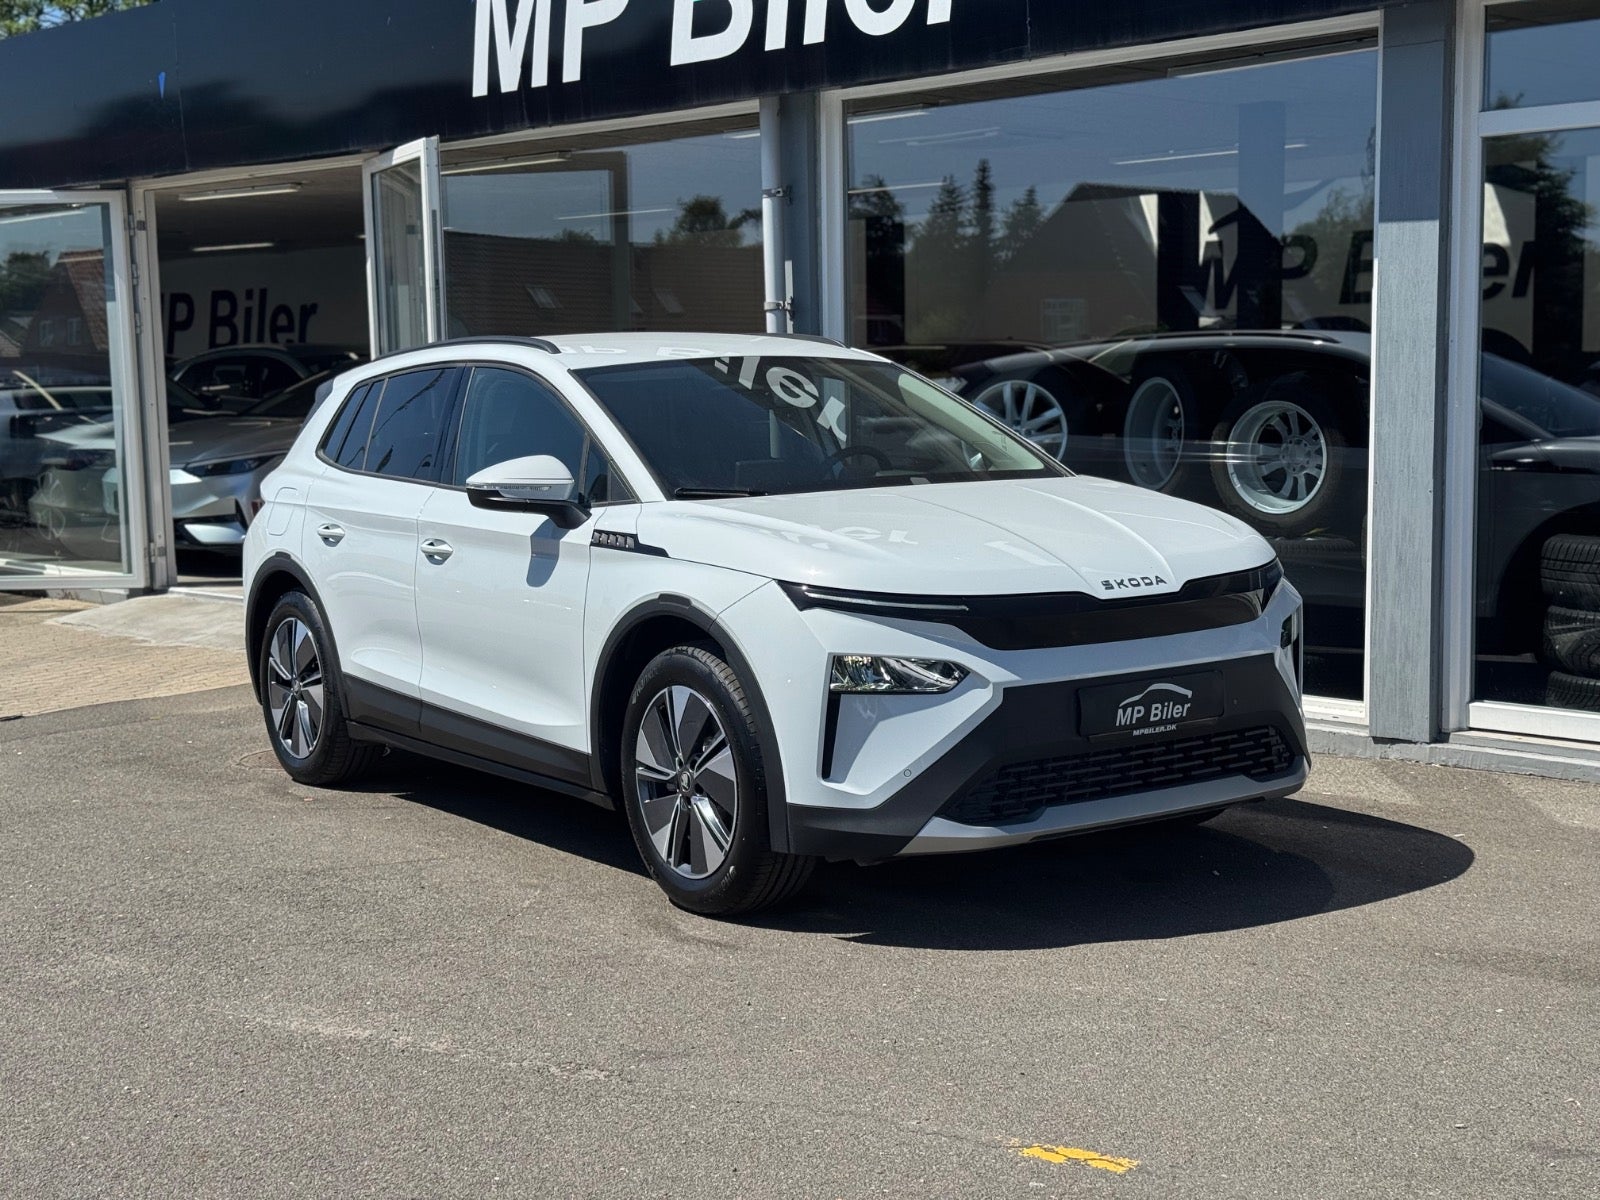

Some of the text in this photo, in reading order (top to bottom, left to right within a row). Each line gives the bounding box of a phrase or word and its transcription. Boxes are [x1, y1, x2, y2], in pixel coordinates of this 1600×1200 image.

[208, 287, 318, 350] Biler
[1115, 701, 1191, 727] MP Biler
[1132, 724, 1177, 736] MPBILER.DK
